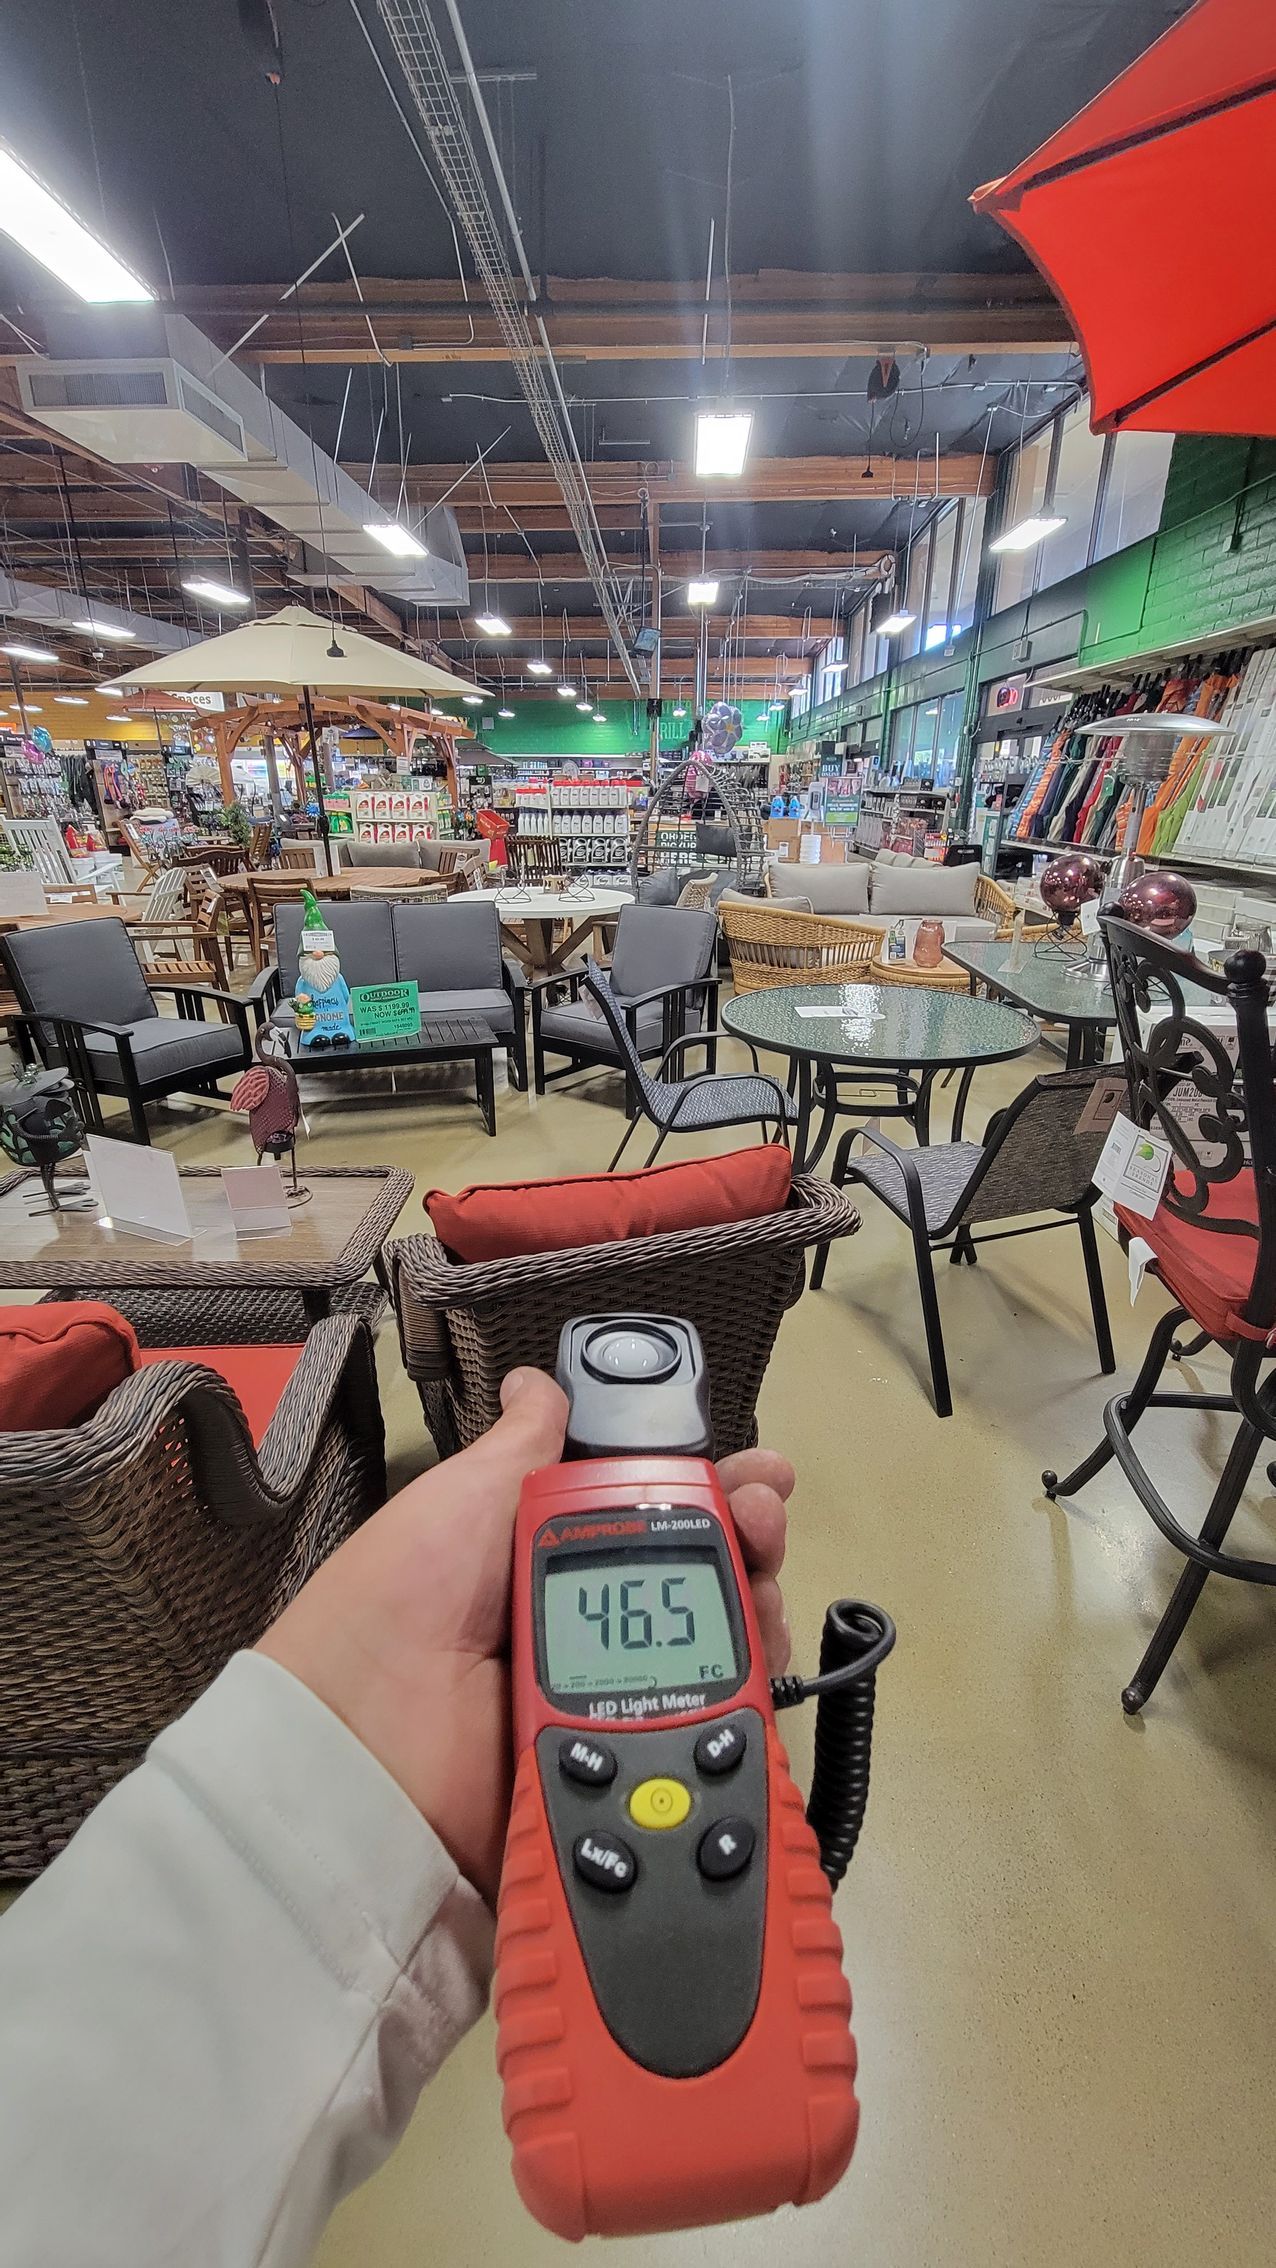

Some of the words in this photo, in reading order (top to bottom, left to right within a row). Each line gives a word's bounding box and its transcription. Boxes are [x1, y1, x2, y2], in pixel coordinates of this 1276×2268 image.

[660, 722, 686, 739] RILL
[822, 764, 840, 772] BUY
[660, 851, 698, 864] HERE
[360, 989, 409, 1002] OUTDOOR
[315, 1012, 344, 1022] GNOME
[360, 1005, 377, 1014] WAS
[374, 1011, 391, 1019] NOW
[560, 1520, 646, 1541] AMPROBE
[651, 1518, 711, 1532] LM-200LED
[578, 1577, 695, 1650] 46.5
[699, 1664, 724, 1680] FC
[589, 1701, 618, 1717] LED
[621, 1695, 659, 1717] Light
[662, 1692, 706, 1710] Meter
[706, 1729, 735, 1758] D-H
[570, 1742, 603, 1772] M-H
[718, 1834, 737, 1855] R
